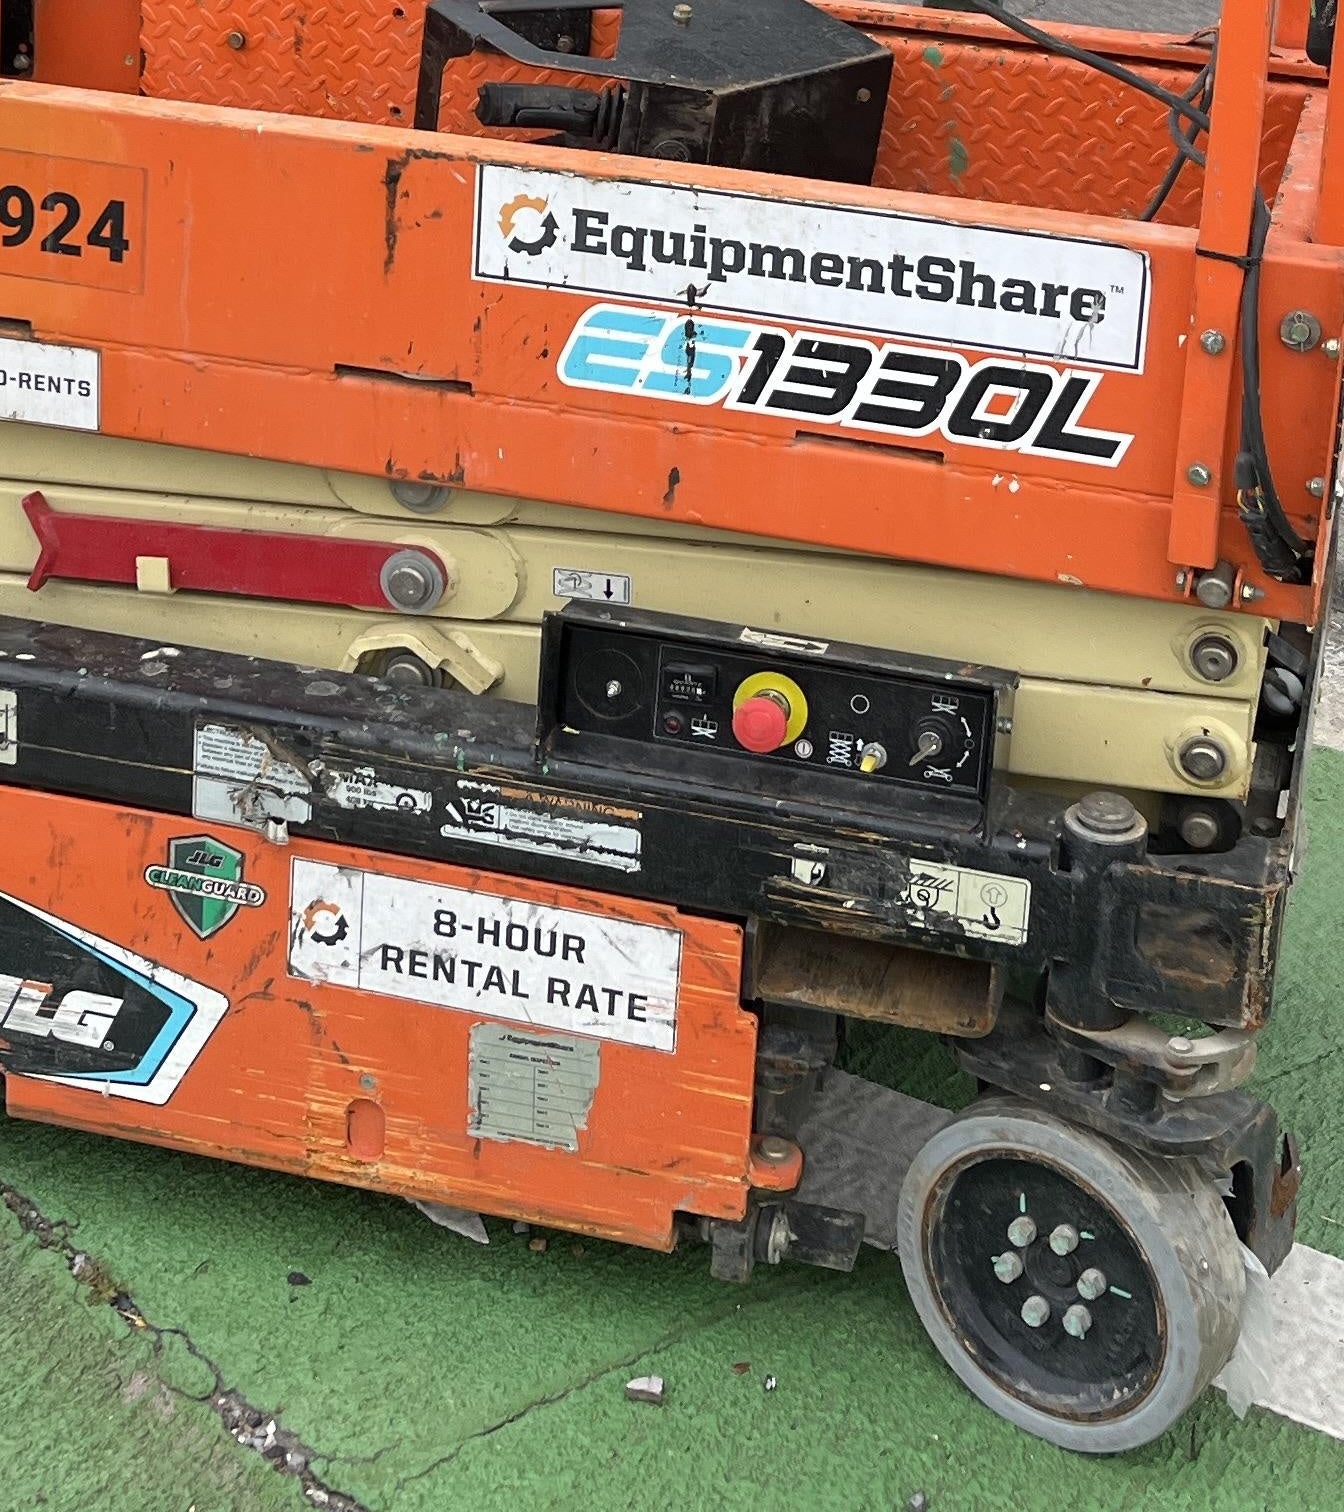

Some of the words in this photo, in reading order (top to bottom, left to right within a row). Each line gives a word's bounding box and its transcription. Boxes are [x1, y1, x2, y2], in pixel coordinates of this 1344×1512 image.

[570, 207, 1107, 325] EquipmentShare
[560, 307, 1130, 464] ES1330L
[148, 868, 260, 903] CLEANGUARD
[186, 849, 225, 869] JLG
[433, 909, 586, 964] 8-HOUR
[380, 943, 530, 999] RENTAL
[547, 977, 648, 1022] RATE
